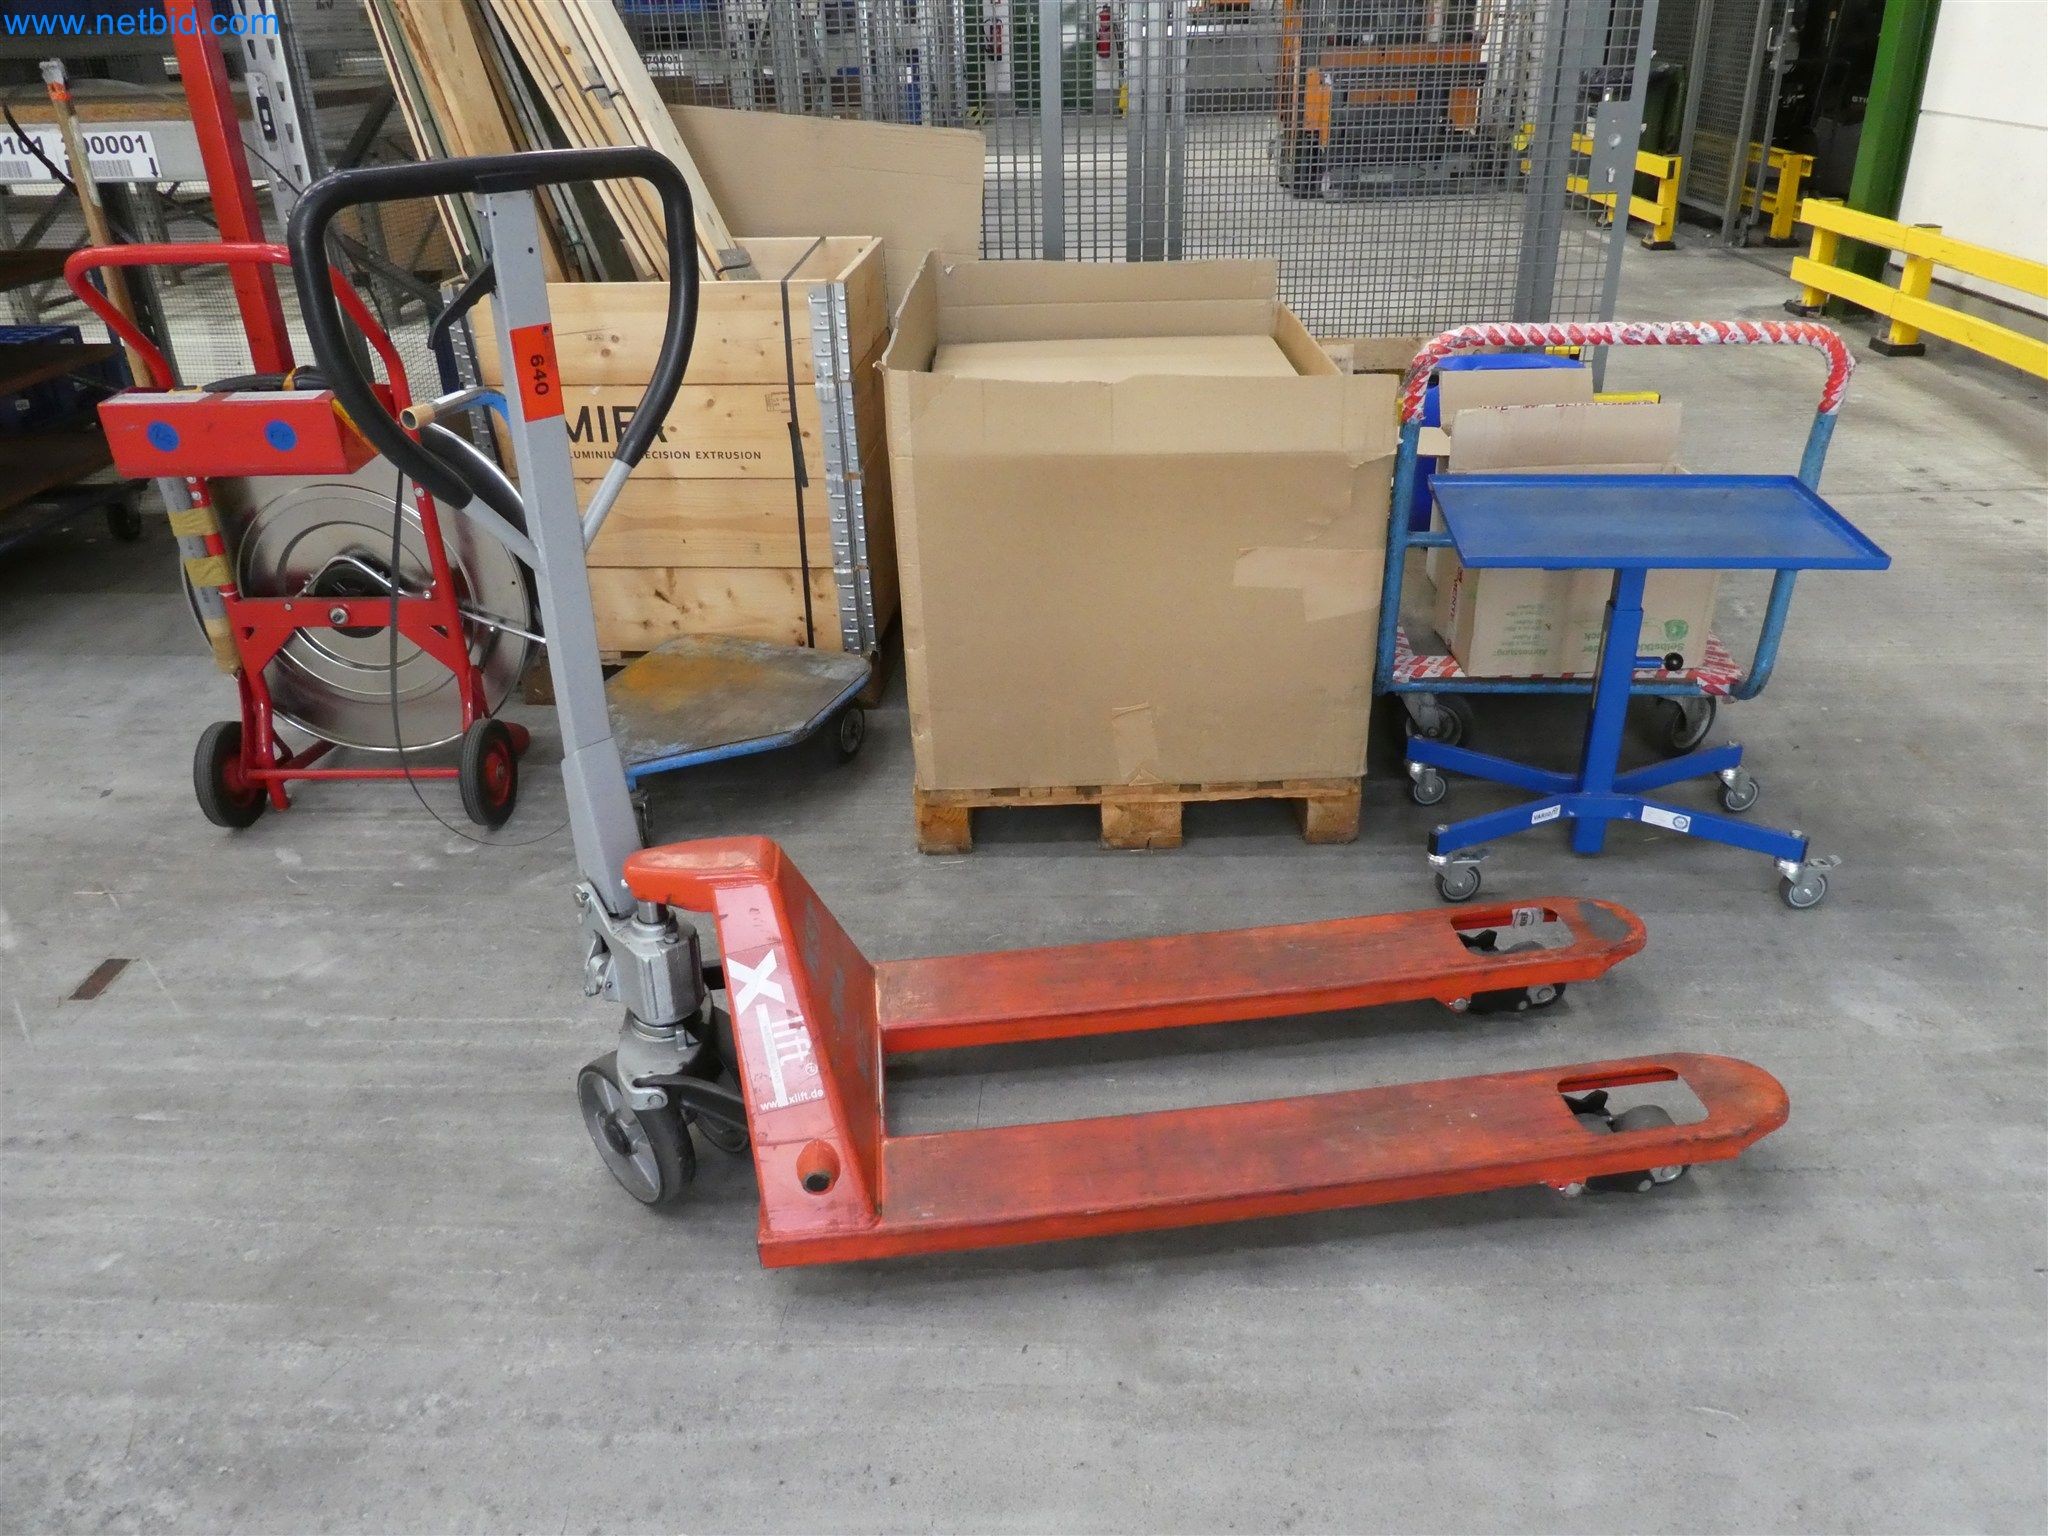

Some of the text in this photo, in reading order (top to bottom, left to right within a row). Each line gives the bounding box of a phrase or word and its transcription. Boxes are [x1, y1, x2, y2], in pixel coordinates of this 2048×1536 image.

[0, 136, 45, 155] 101
[531, 354, 549, 395] 640
[696, 451, 761, 460] EXTRUSION
